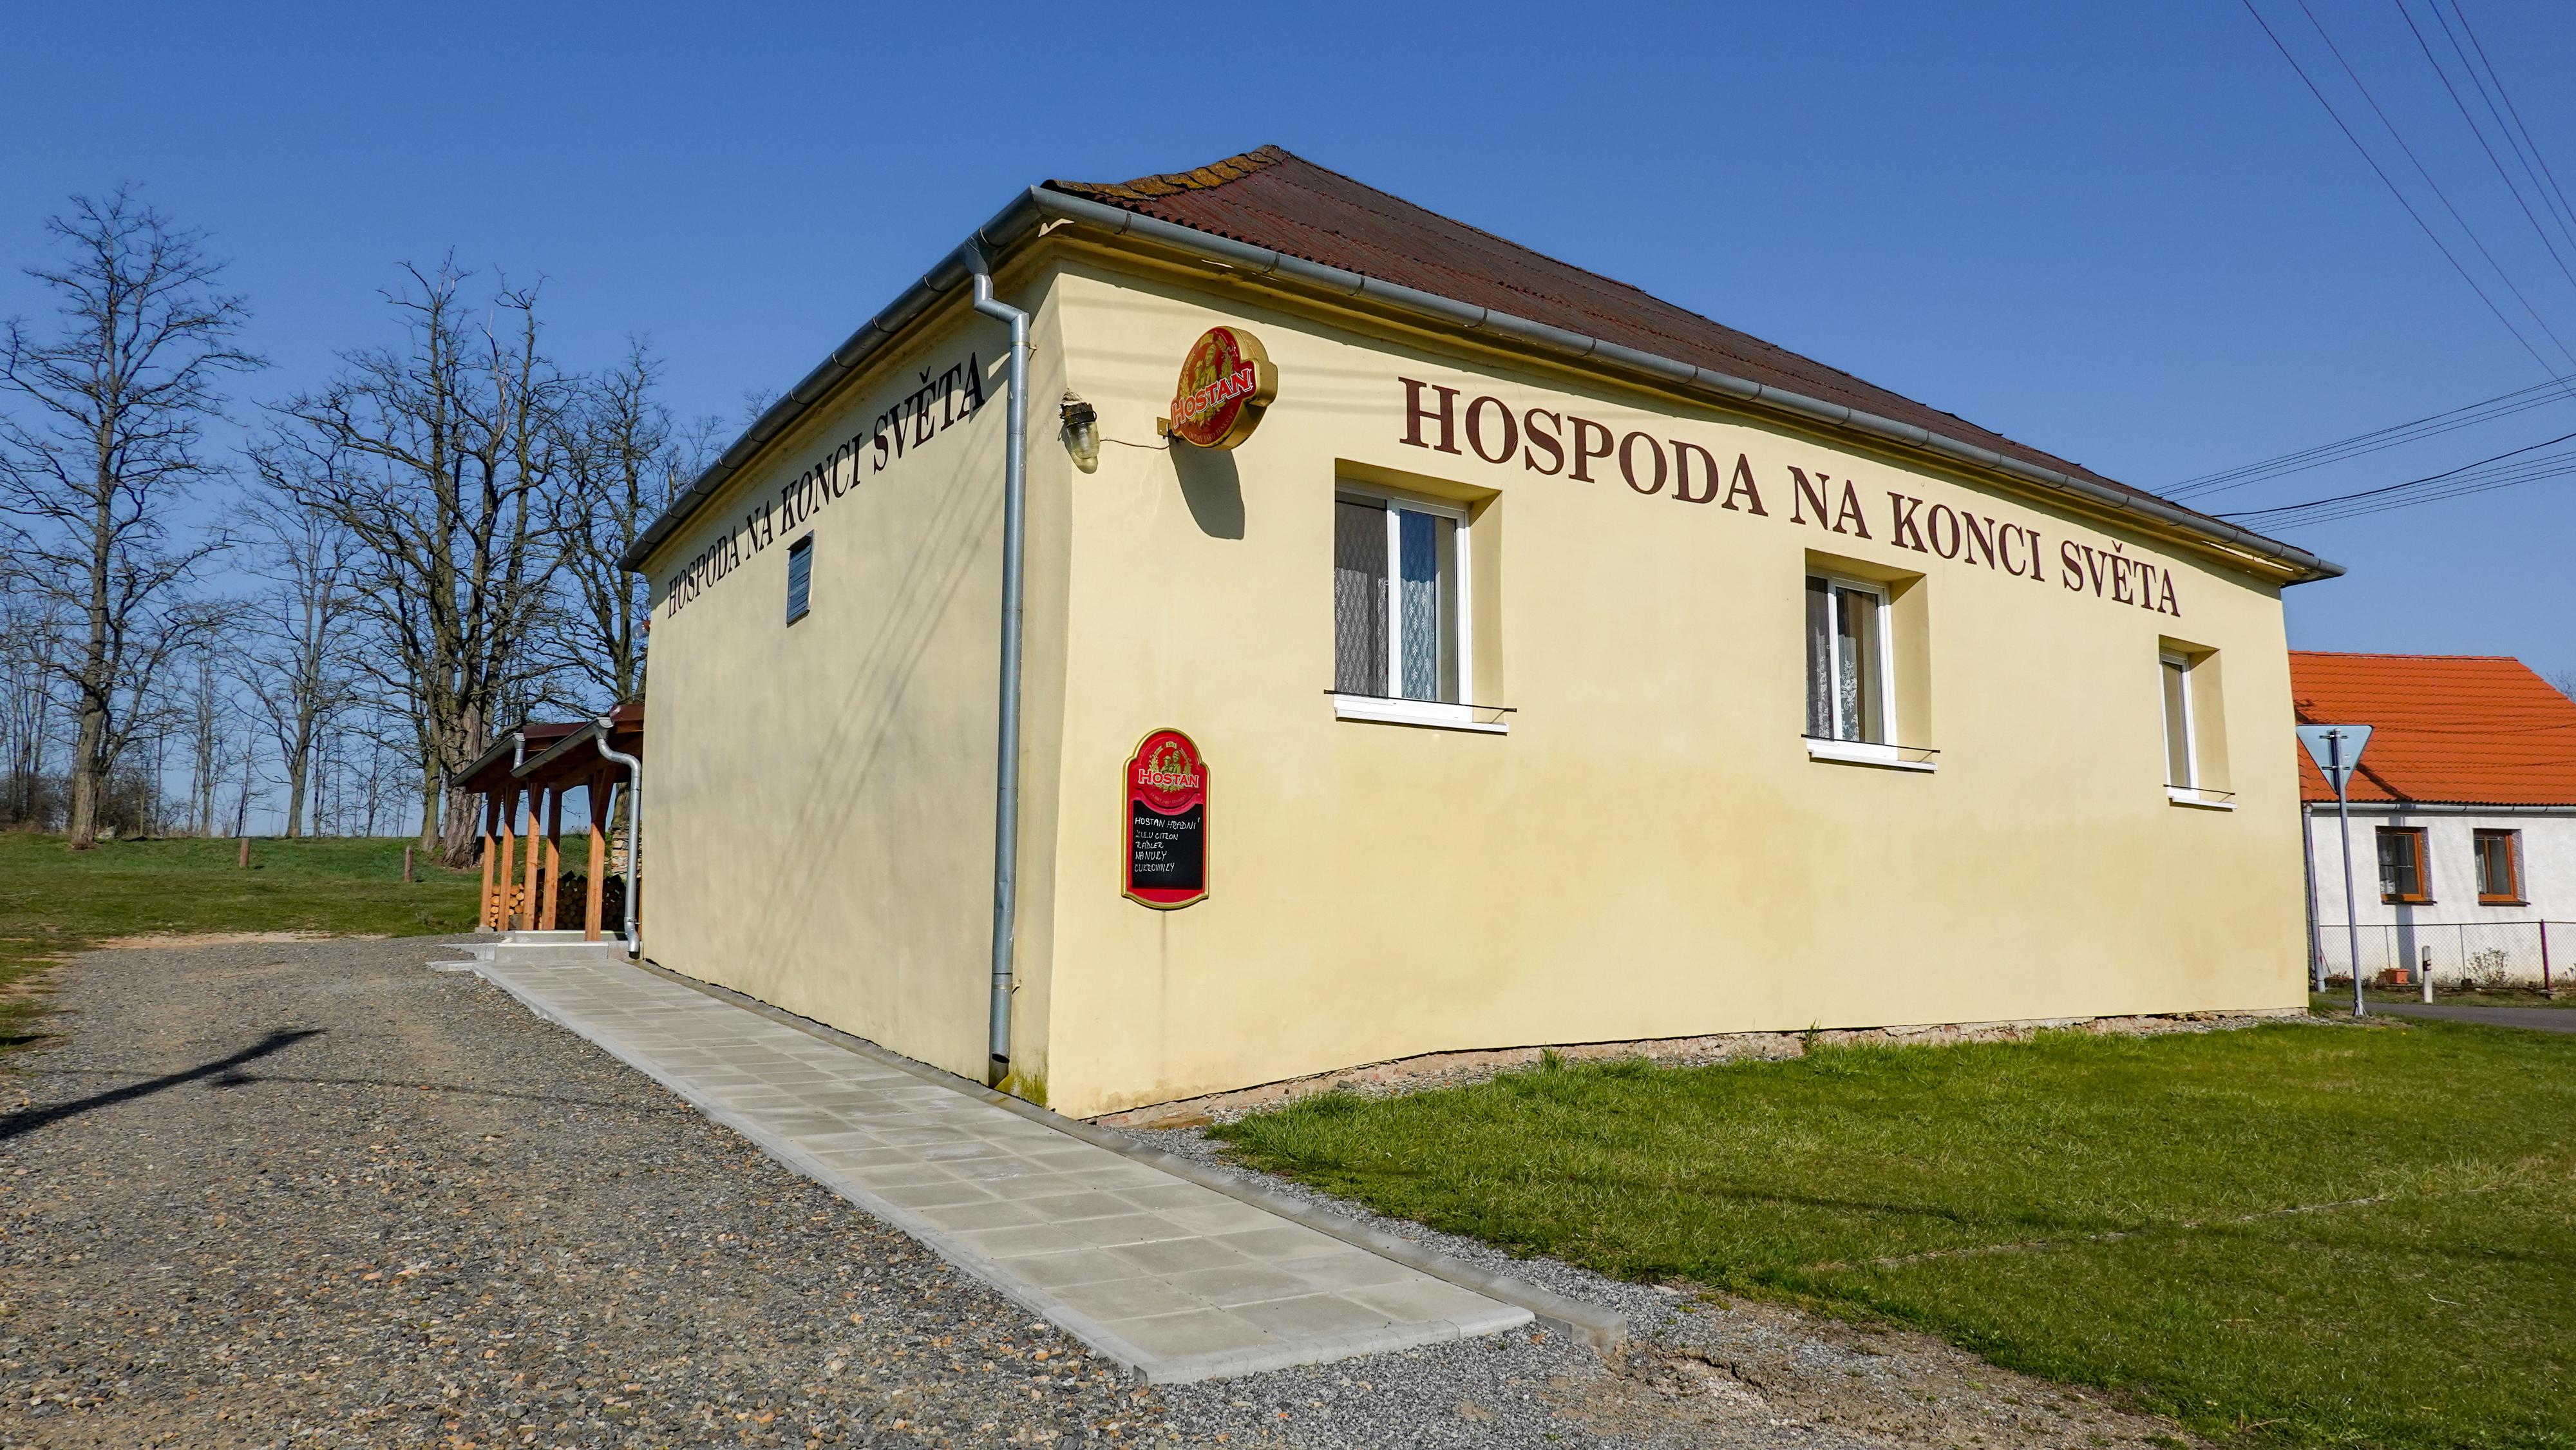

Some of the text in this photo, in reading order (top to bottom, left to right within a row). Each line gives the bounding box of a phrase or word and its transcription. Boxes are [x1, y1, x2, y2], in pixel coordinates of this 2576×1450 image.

[1171, 368, 1253, 430] HOSTAN
[668, 352, 985, 619] HOSPODA NA KONCI SVĚTA
[1398, 376, 2181, 618] HOSPODA NA KONCI SVĚTA
[1138, 768, 1199, 788] HOSTAN
[1135, 817, 1166, 828] HOSTAN
[1135, 850, 1167, 861] NANUKY
